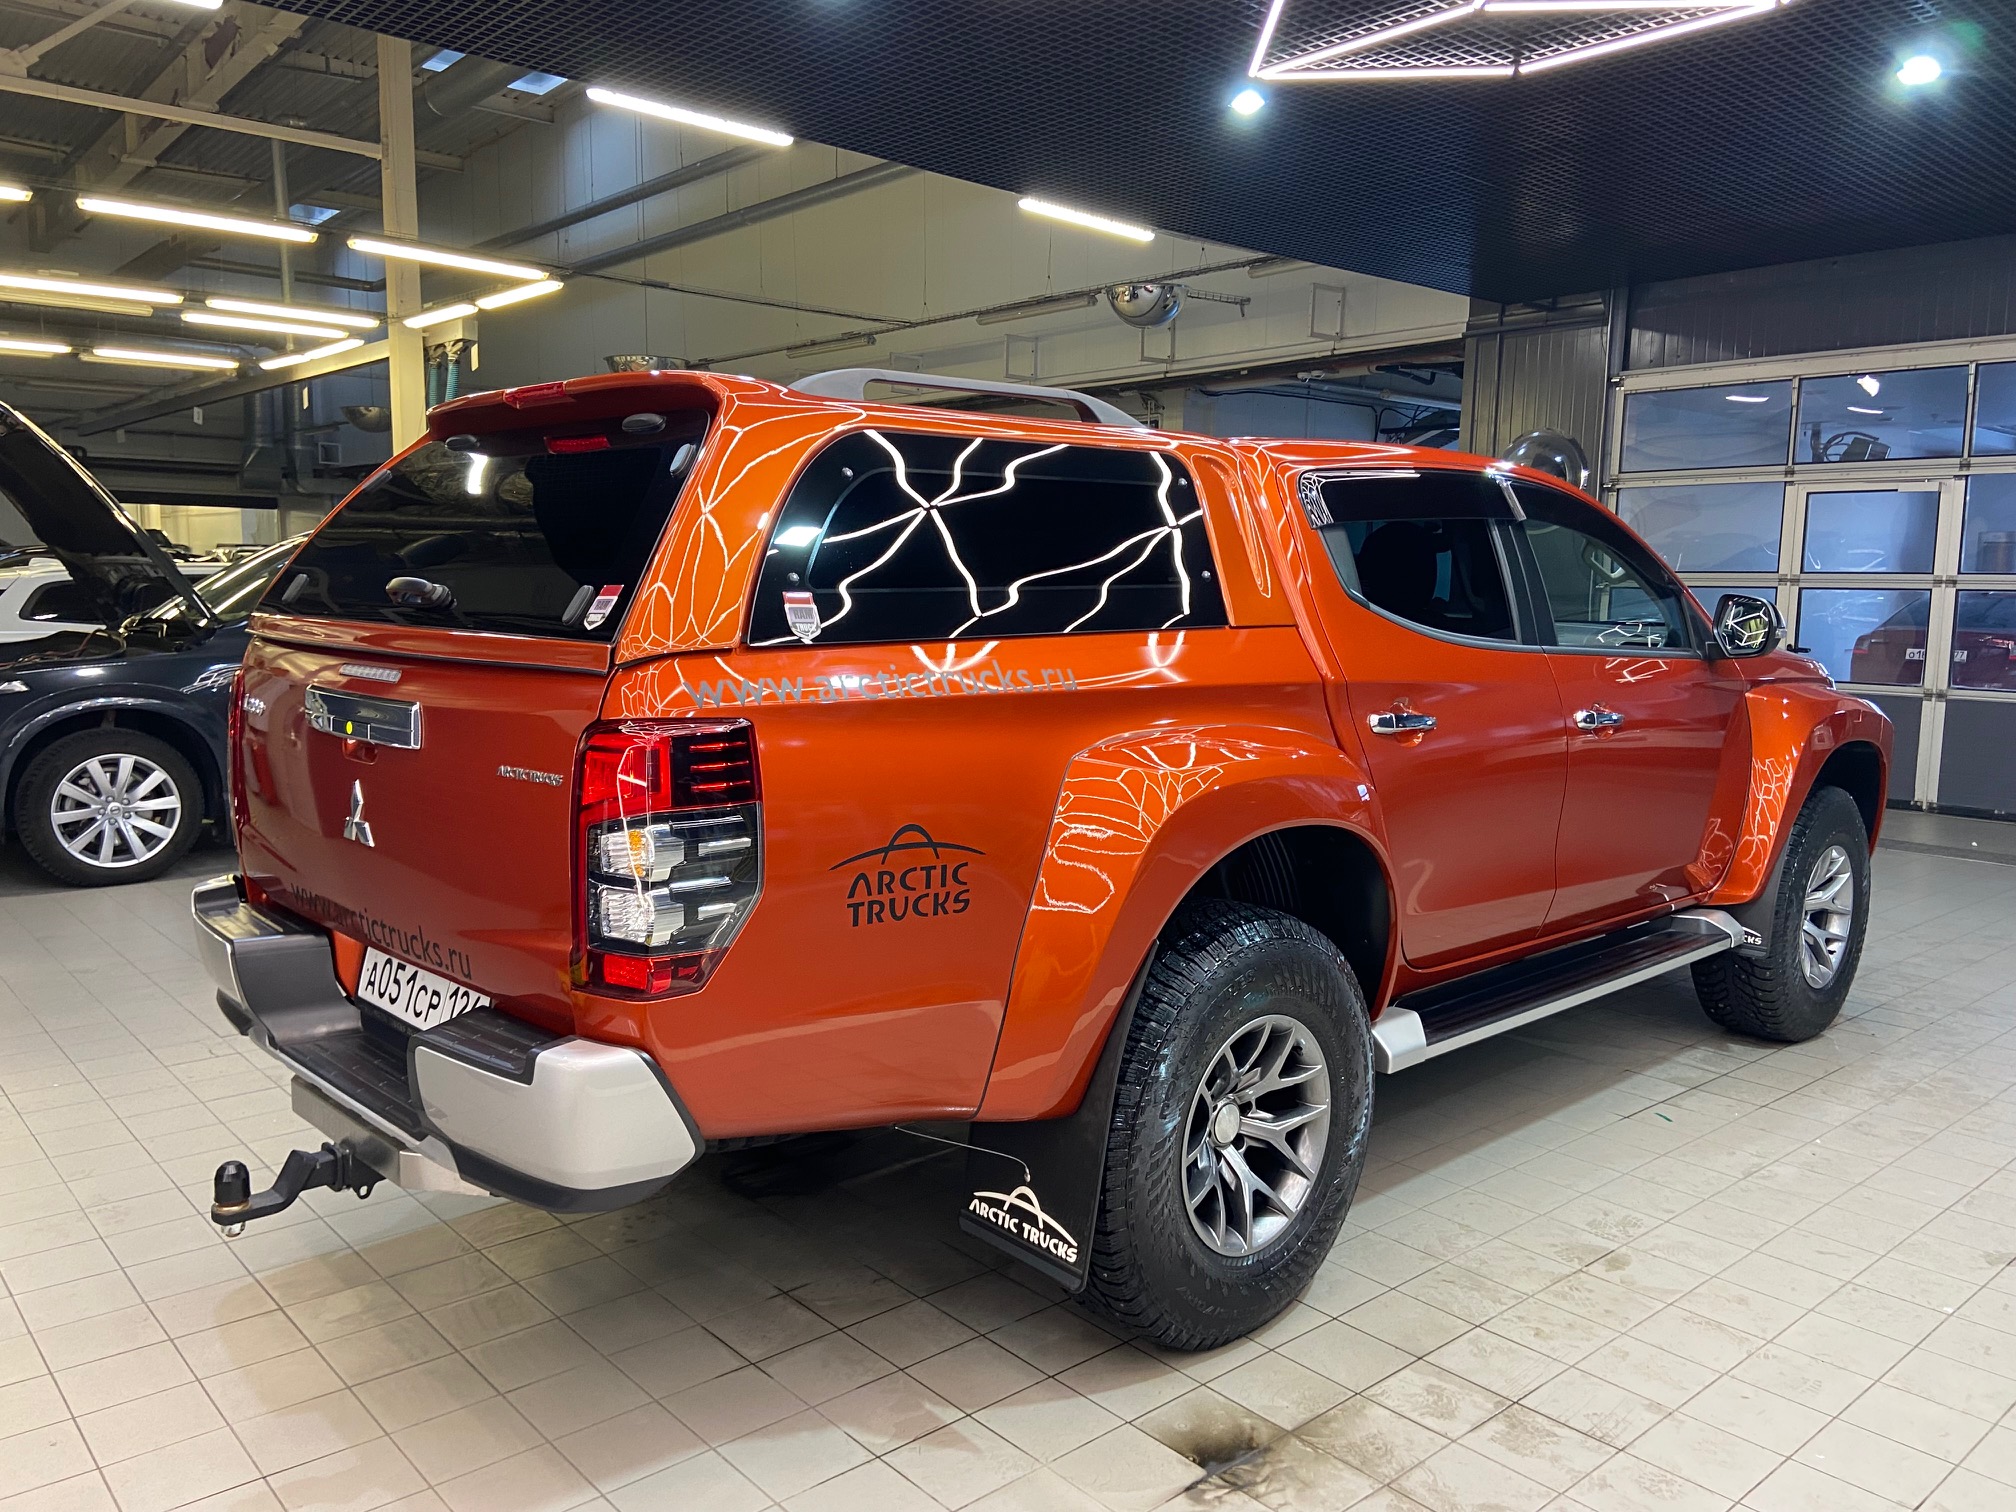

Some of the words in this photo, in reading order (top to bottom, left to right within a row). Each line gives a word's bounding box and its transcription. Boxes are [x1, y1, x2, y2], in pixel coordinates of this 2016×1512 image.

[683, 659, 1078, 709] www.arctictrucks.ru
[846, 861, 969, 899] ARCTIC
[290, 882, 473, 981] www.arctictrucks.ru
[846, 888, 970, 928] TRUCKS
[968, 1198, 1019, 1234] ARCTIC
[1022, 1222, 1078, 1264] TRUCKS
